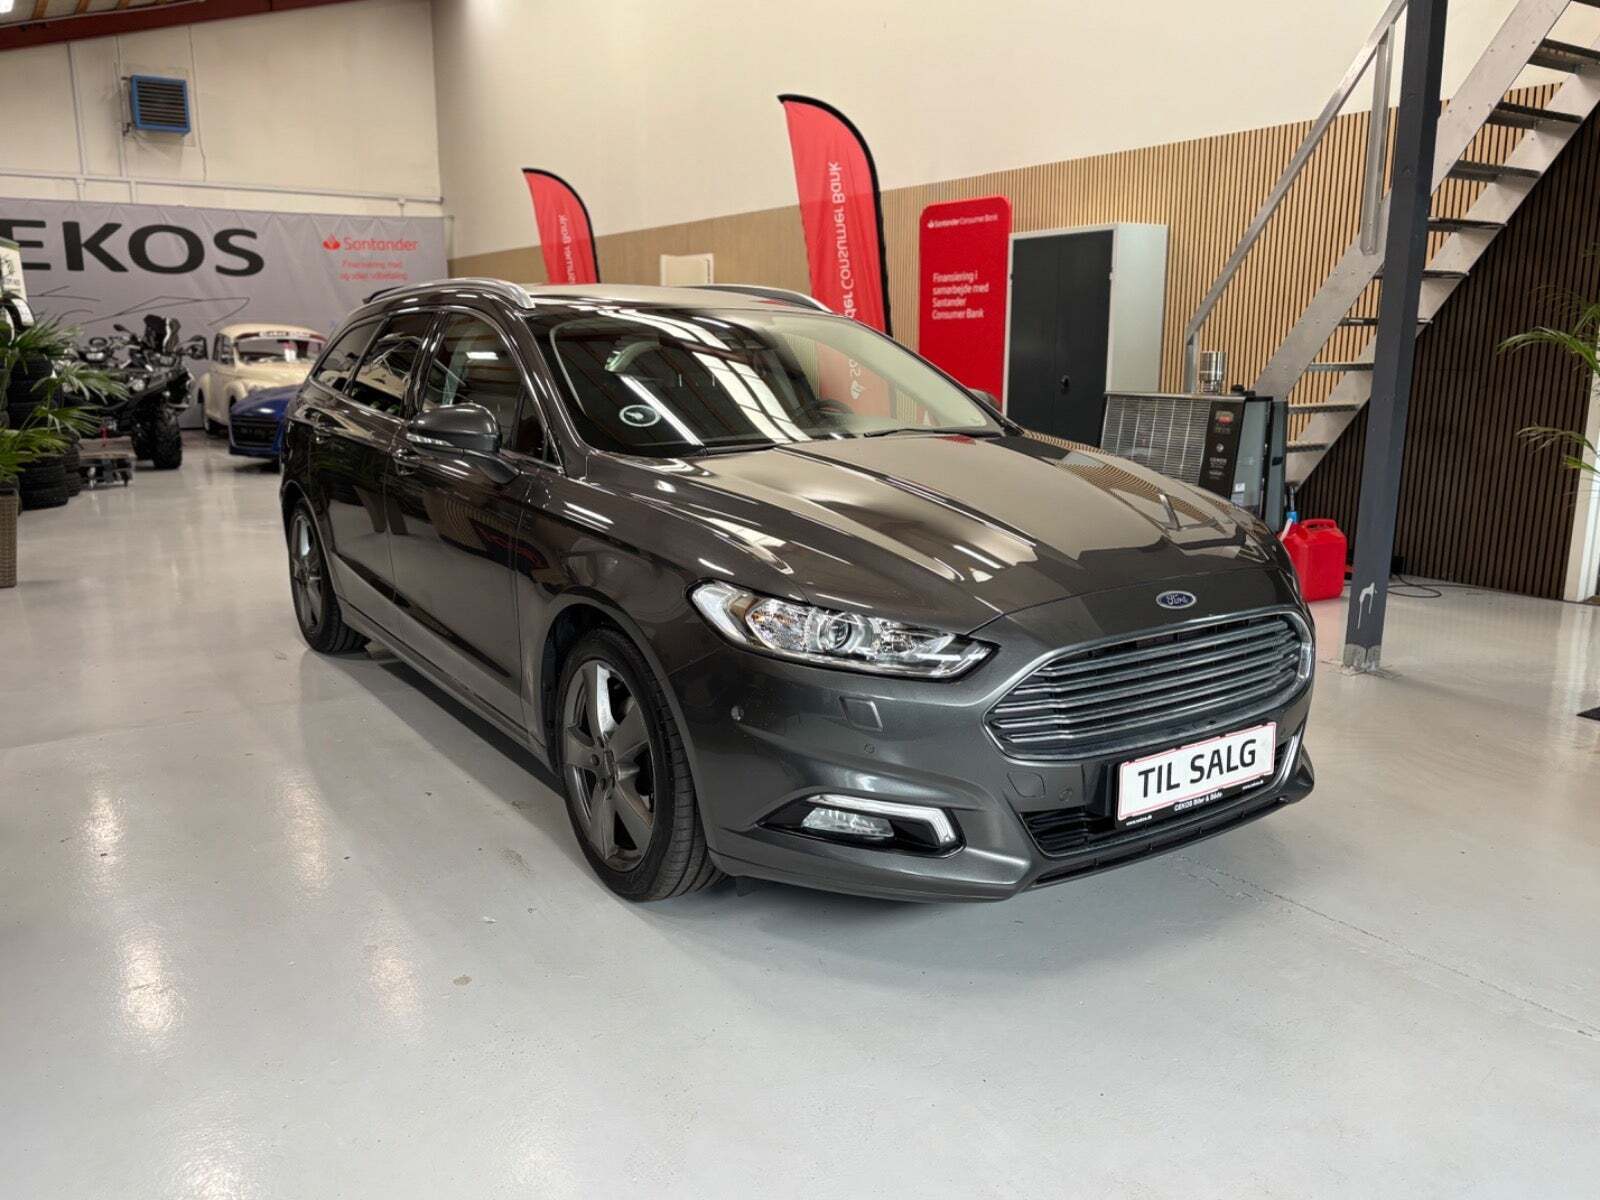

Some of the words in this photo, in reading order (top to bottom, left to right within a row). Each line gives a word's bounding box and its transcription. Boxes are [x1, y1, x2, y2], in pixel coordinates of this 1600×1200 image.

[343, 235, 418, 251] Santander
[973, 283, 989, 293] med
[932, 297, 967, 308] Santander
[932, 309, 965, 319] Consumer
[966, 308, 984, 319] Bank
[1138, 762, 1180, 798] TIL
[1190, 739, 1257, 784] SALG
